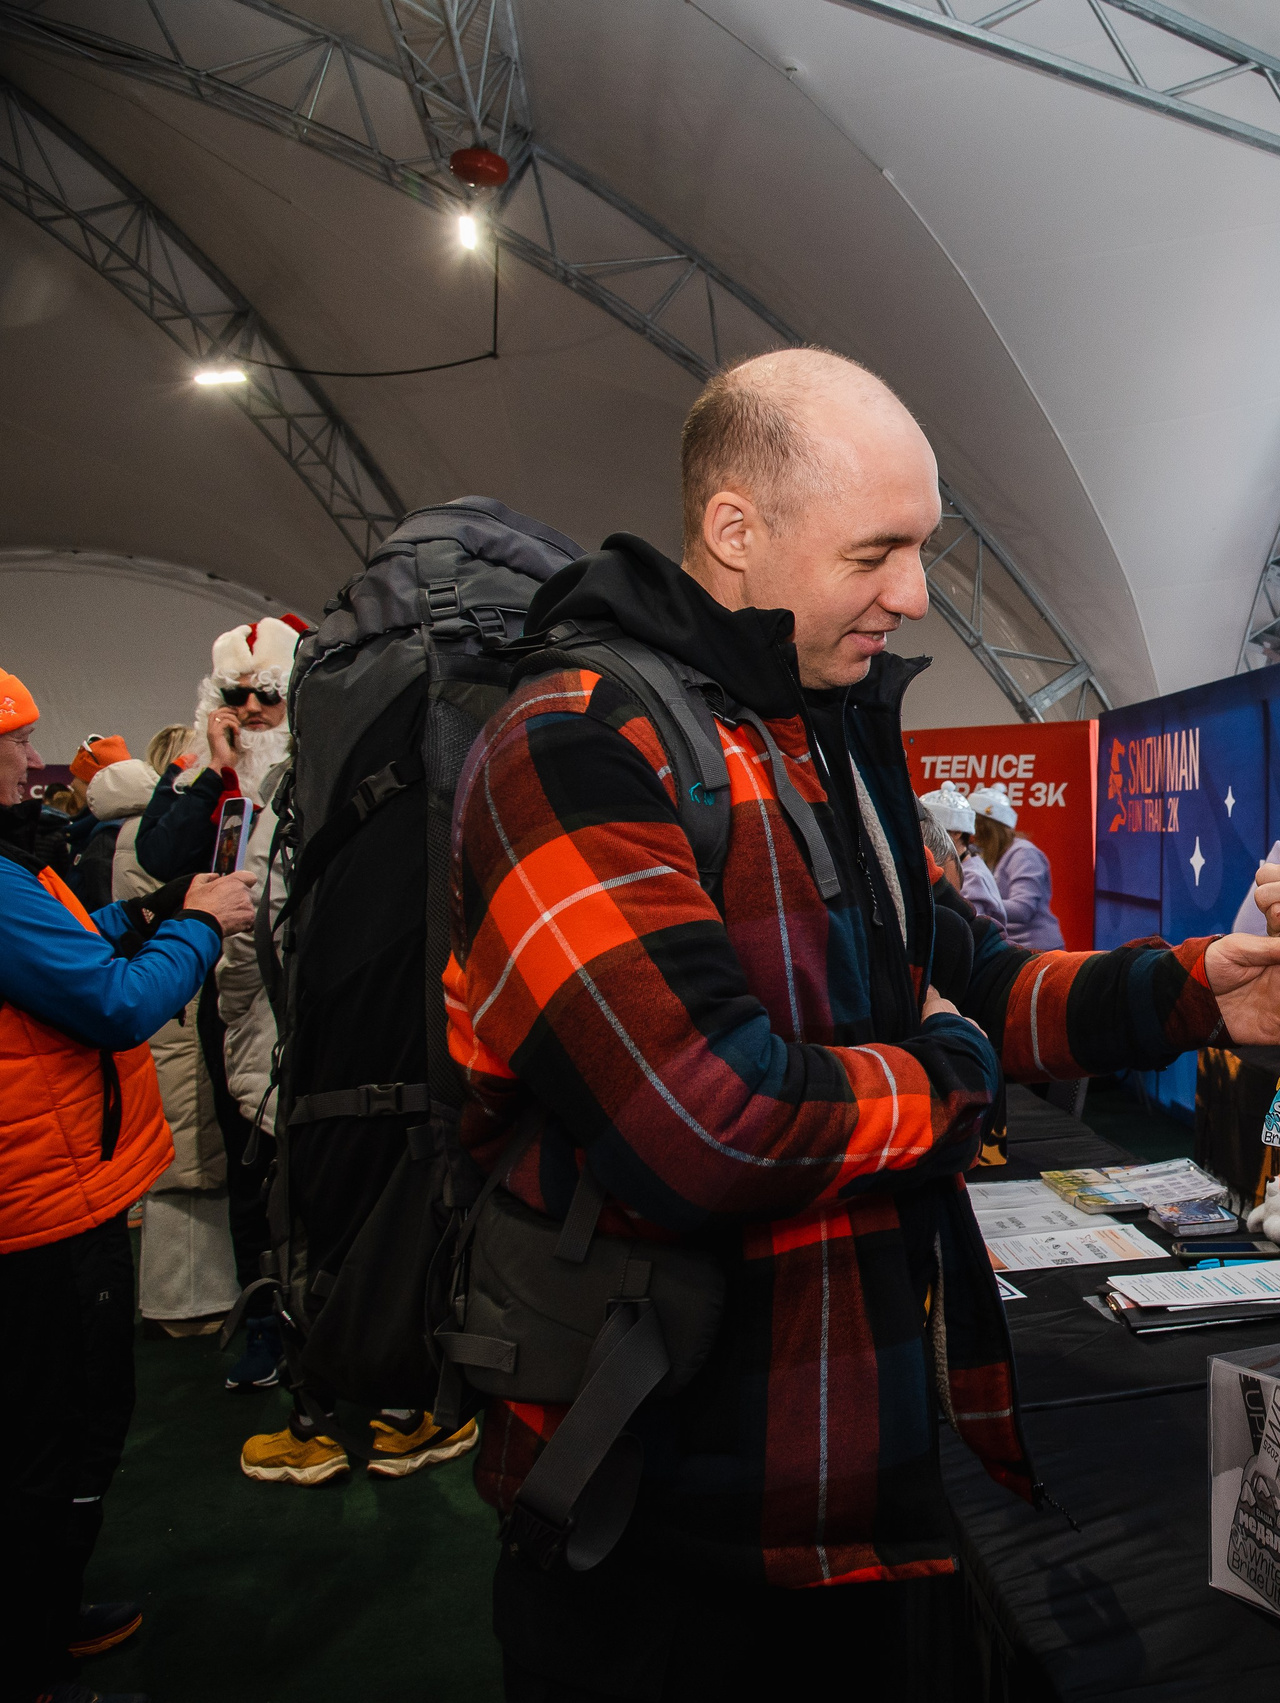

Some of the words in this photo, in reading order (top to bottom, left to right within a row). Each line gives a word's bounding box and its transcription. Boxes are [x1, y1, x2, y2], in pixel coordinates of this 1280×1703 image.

[920, 755, 987, 779] TEEN
[991, 754, 1036, 779] ICE
[1128, 727, 1199, 795] SNOWMAN
[1028, 782, 1068, 807] 3K
[1167, 797, 1179, 832] 2K
[1262, 1440, 1280, 1463] 2025
